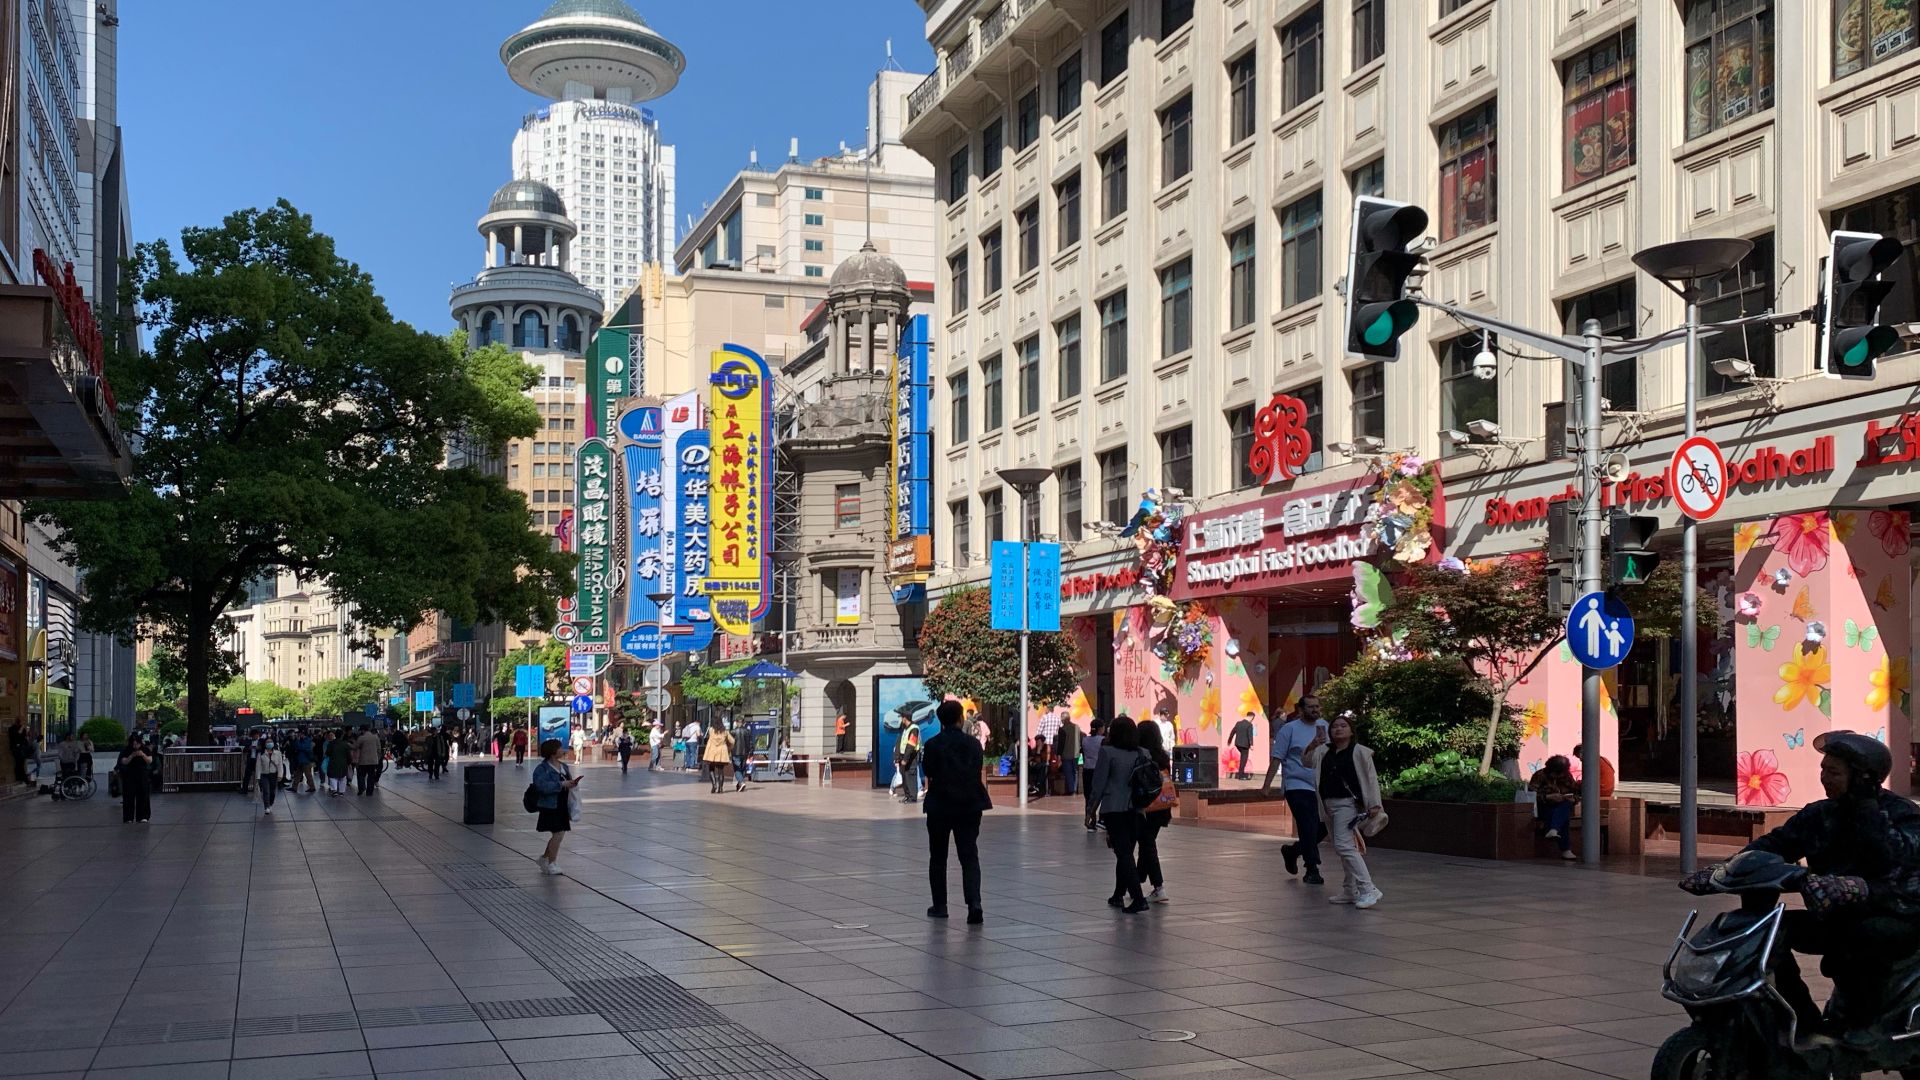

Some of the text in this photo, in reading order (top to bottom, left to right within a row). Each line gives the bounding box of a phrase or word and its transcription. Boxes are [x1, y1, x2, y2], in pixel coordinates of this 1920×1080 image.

[573, 99, 641, 125] Radisson
[581, 454, 608, 546] 茂昌眼镜
[683, 478, 708, 597] 华美大药房
[1188, 551, 1260, 583] Shanghai
[1261, 545, 1296, 571] First
